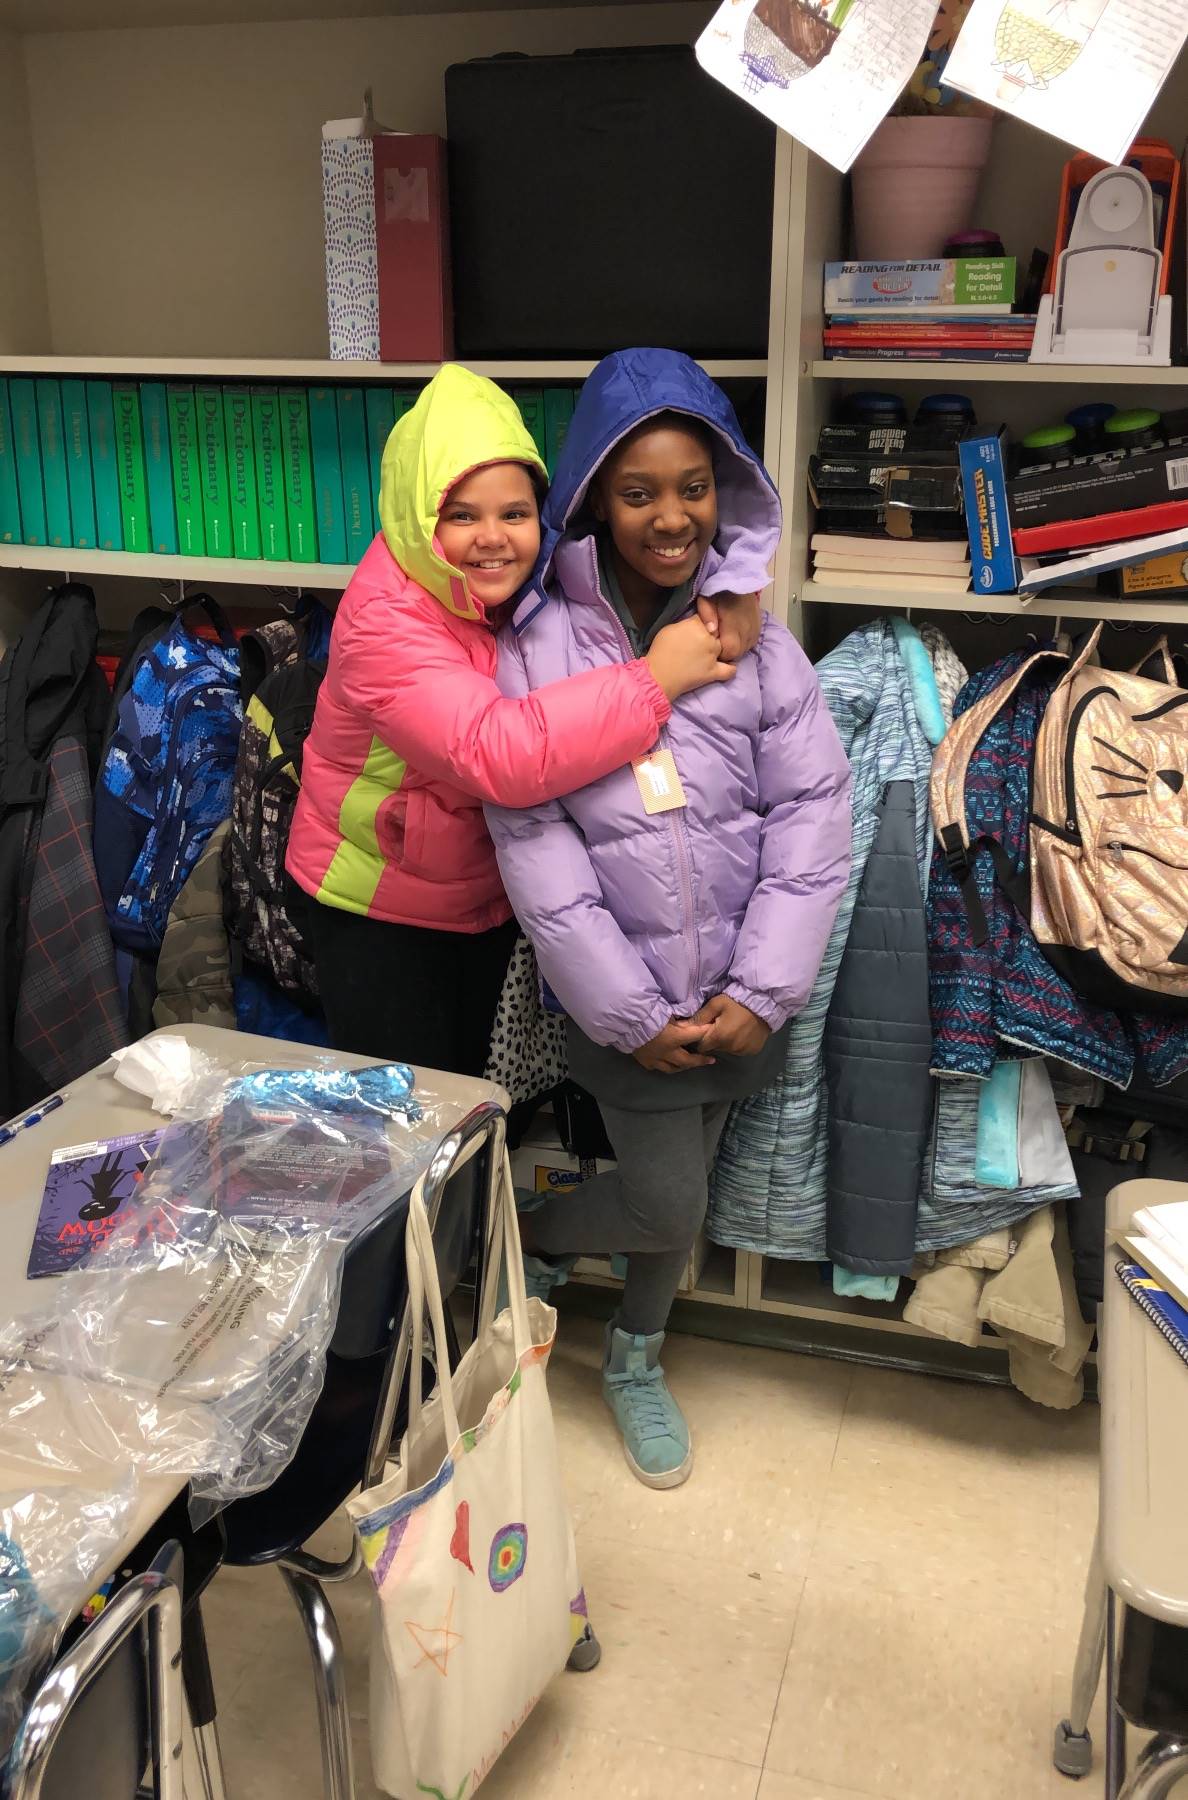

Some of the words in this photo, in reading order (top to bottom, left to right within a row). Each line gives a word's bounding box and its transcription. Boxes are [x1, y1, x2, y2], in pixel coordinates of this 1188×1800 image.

[840, 265, 889, 274] READING
[905, 264, 942, 272] DETAIL
[966, 284, 978, 292] for
[980, 282, 1003, 291] Detail
[968, 272, 1002, 282] Reading
[877, 349, 904, 357] Progress
[120, 395, 136, 503] Dictionary
[175, 396, 192, 505] Dictionary
[203, 396, 220, 506] Dictionary
[232, 399, 248, 509] Dictionary
[260, 399, 276, 512] Dictionary
[287, 399, 303, 510] Dictionary
[973, 468, 989, 525] MASTER
[979, 526, 994, 561] CODE
[210, 1279, 225, 1296] BAG
